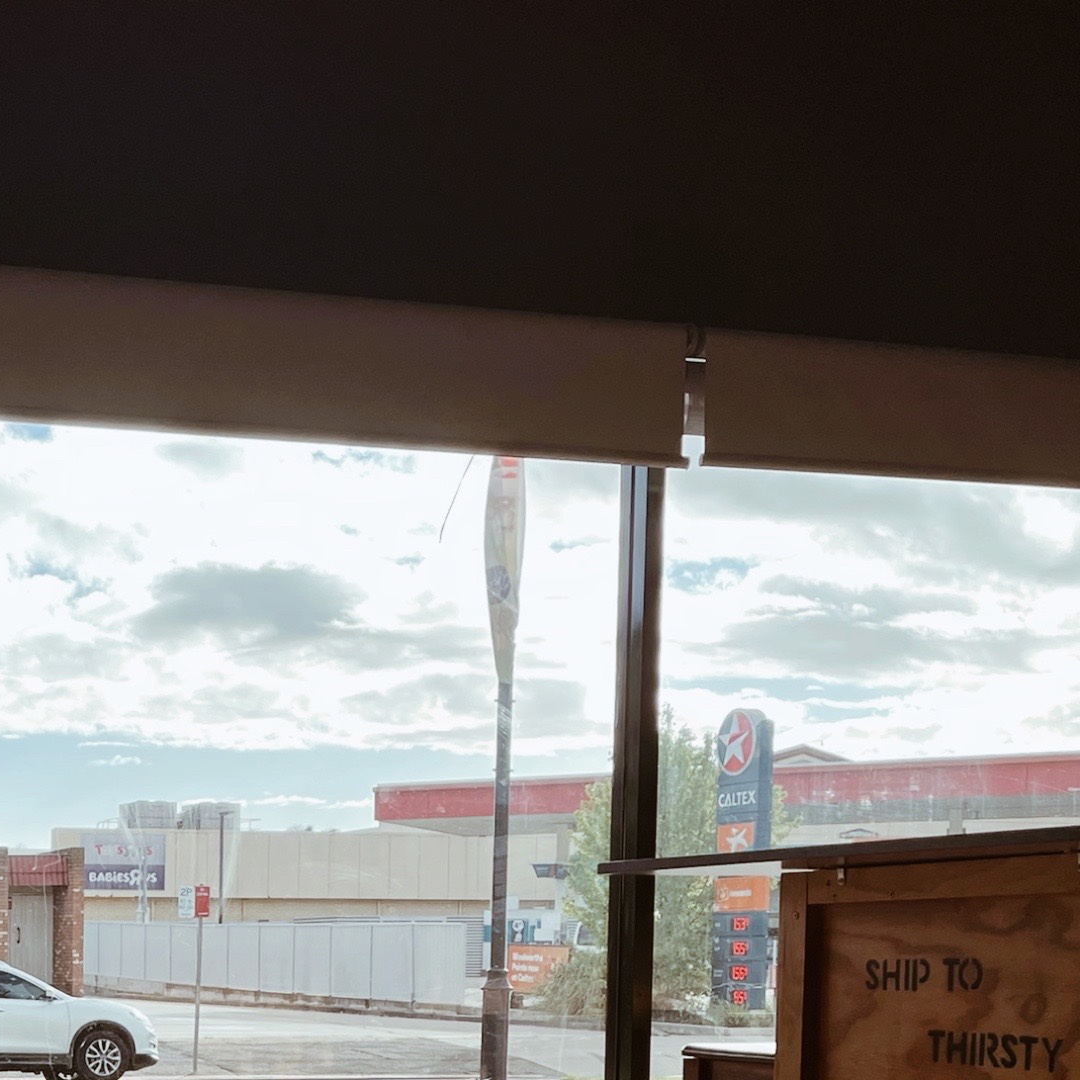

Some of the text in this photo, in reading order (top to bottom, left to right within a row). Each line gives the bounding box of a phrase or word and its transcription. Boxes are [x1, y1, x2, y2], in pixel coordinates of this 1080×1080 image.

[718, 789, 757, 808] CALTEX
[865, 957, 984, 992] SHIP TO
[927, 1029, 1064, 1073] THIRSTY
